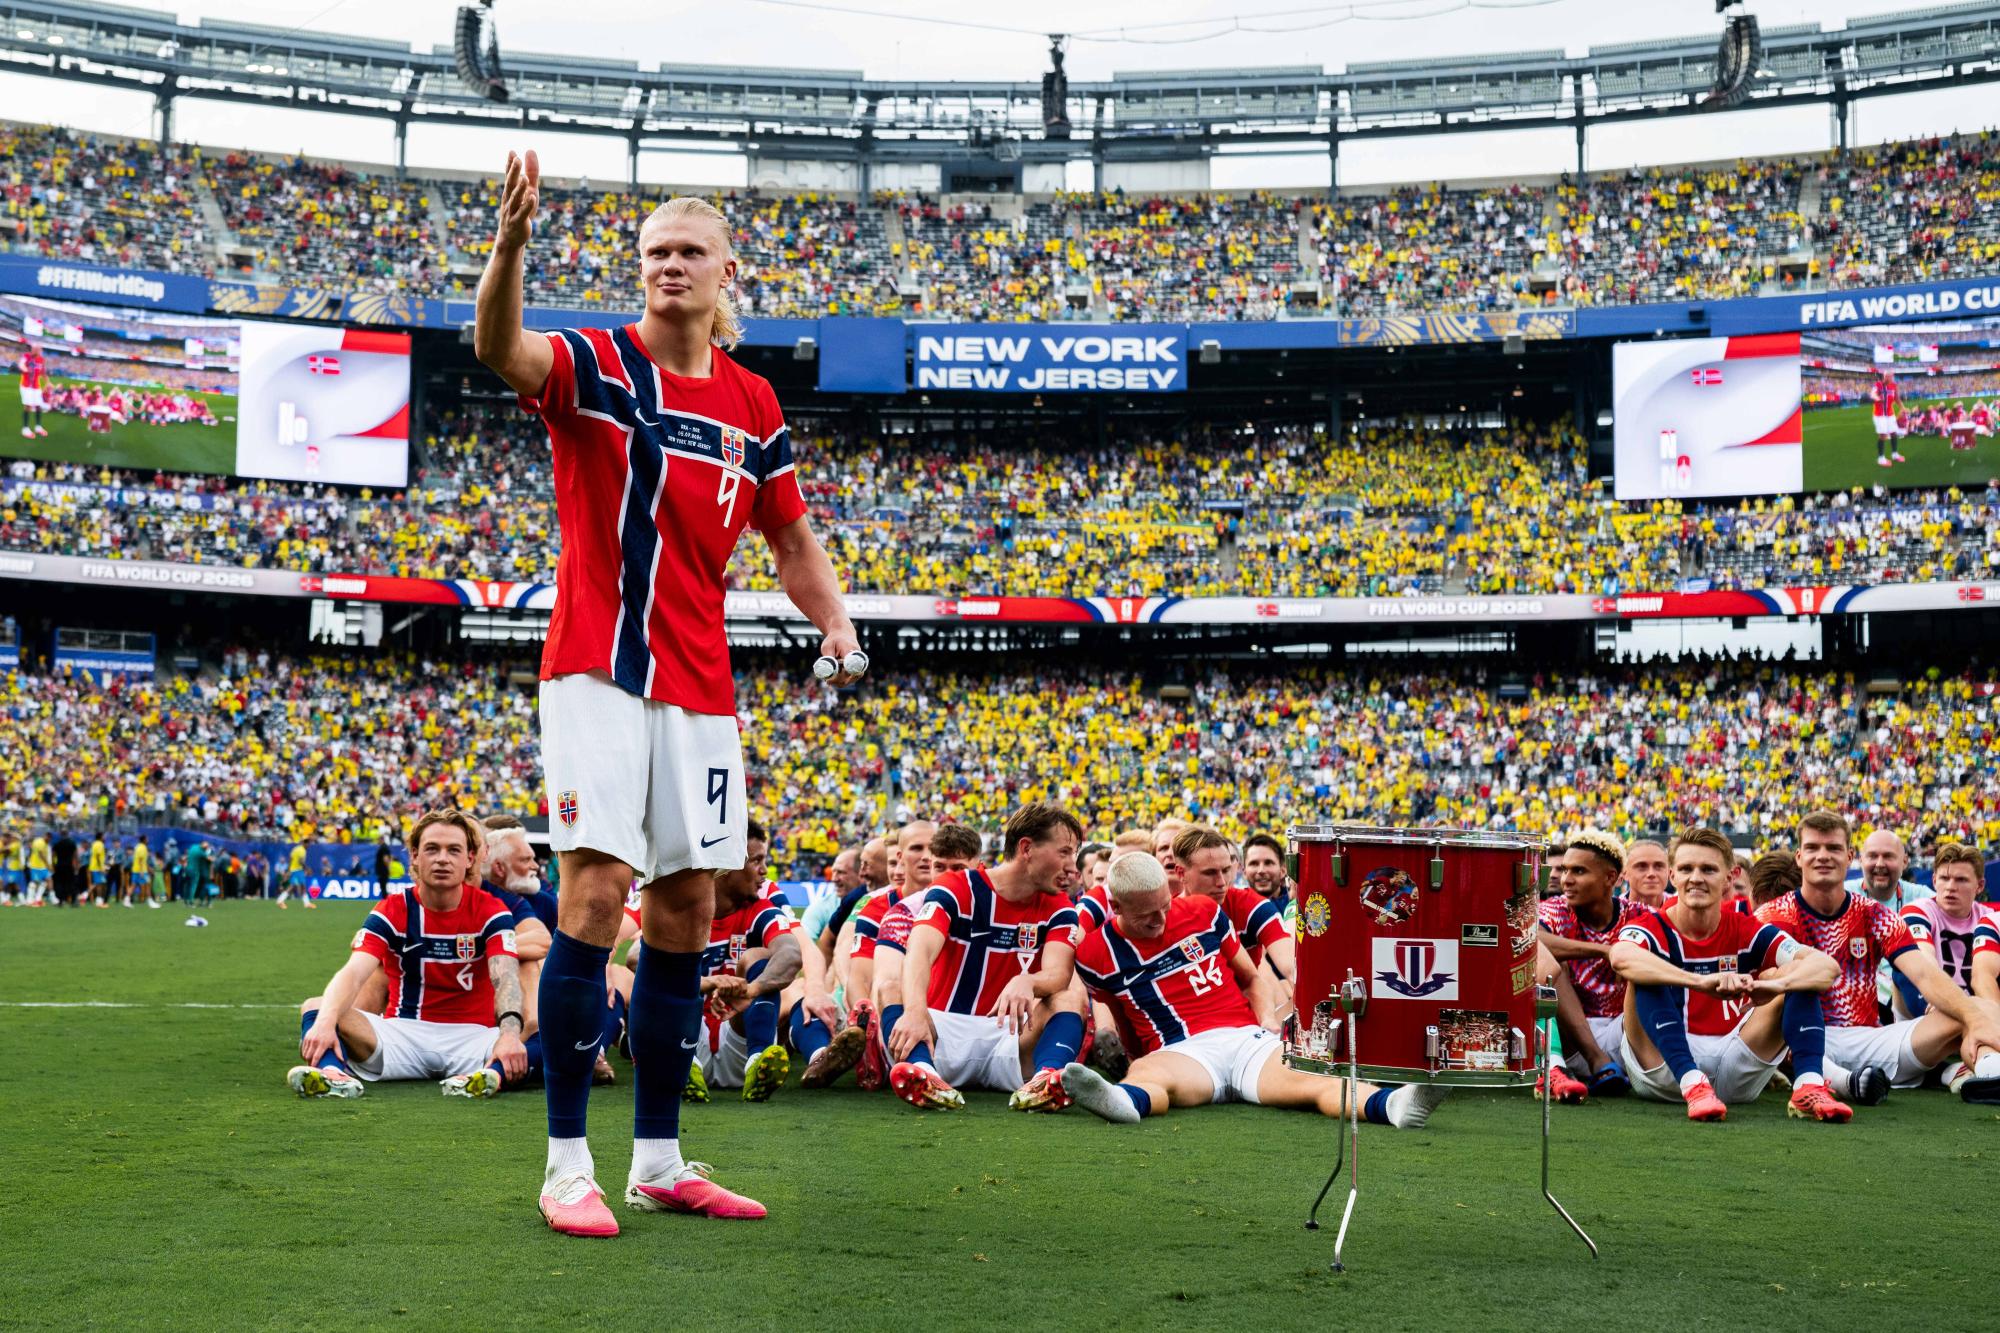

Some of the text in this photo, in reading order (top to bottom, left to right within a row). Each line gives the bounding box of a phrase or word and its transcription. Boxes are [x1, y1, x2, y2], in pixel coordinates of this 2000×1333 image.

[37, 265, 164, 302] #FIFAWorldCup
[1801, 300, 1858, 325] FIFA
[1861, 290, 1960, 319] WORLD
[918, 336, 1179, 363] NEW YORK
[918, 367, 1179, 390] NEW JERSEY
[717, 467, 742, 529] 9
[82, 563, 254, 588] FIFA WORLD CUP 2026
[1369, 601, 1543, 616] FIFA WORLD CUP 2026
[1617, 597, 1664, 613] NORWAY
[707, 767, 729, 825] 9
[323, 879, 370, 899] ADI
[456, 963, 474, 991] 6
